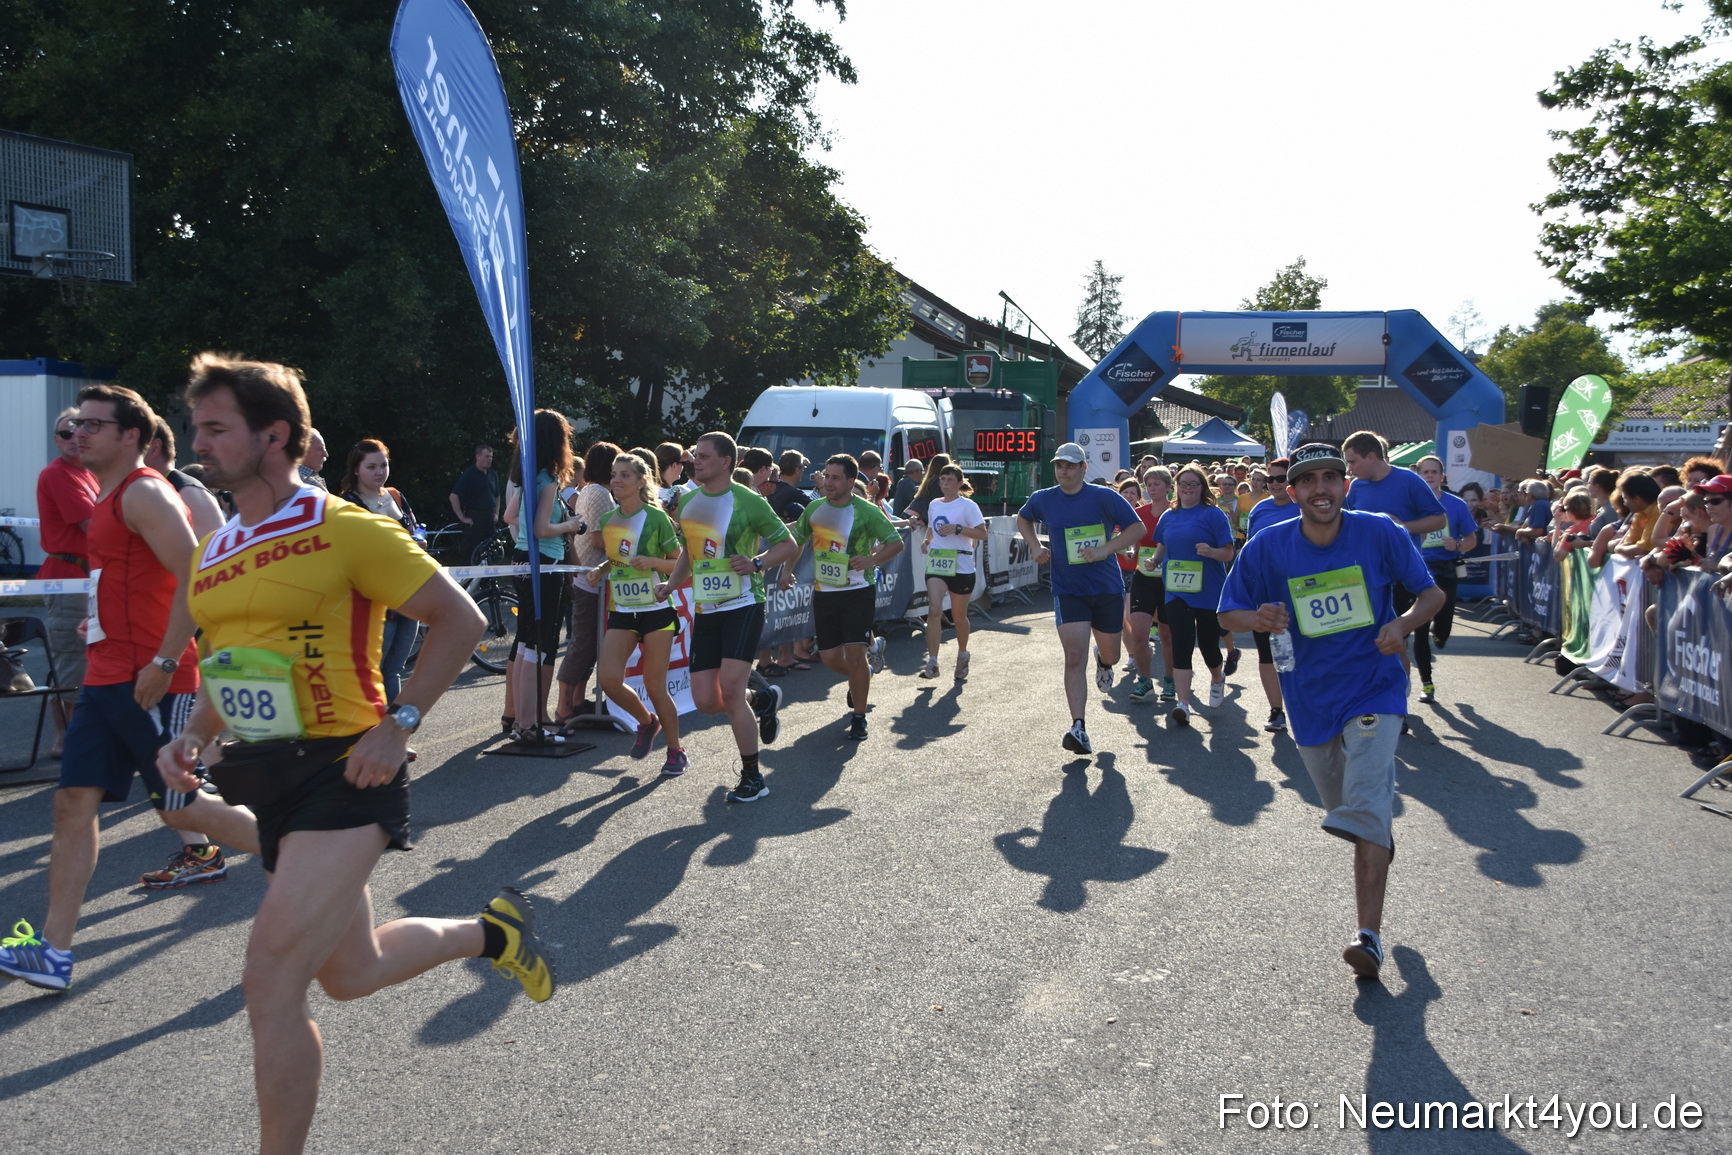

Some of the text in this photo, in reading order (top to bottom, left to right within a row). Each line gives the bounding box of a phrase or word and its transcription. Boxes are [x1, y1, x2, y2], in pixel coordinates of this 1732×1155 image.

[1259, 342, 1337, 357] firmenlauf
[1115, 369, 1155, 378] Fischer
[1577, 410, 1601, 435] AOK
[1617, 423, 1650, 433] Jura
[976, 432, 1036, 452] 000235
[1552, 428, 1579, 456] AOK
[1296, 449, 1333, 461] Spurs
[193, 534, 331, 597] MAX BÖGL
[820, 563, 841, 578] 993
[930, 558, 954, 569] 1487
[702, 576, 732, 591] 994
[1173, 573, 1195, 584] 777
[614, 581, 650, 596] 1004
[766, 583, 815, 613] Fischer
[1309, 592, 1353, 619] 801
[774, 611, 810, 631] AUTOMOBILE
[1674, 630, 1722, 681] Fischer
[221, 687, 276, 720] 898
